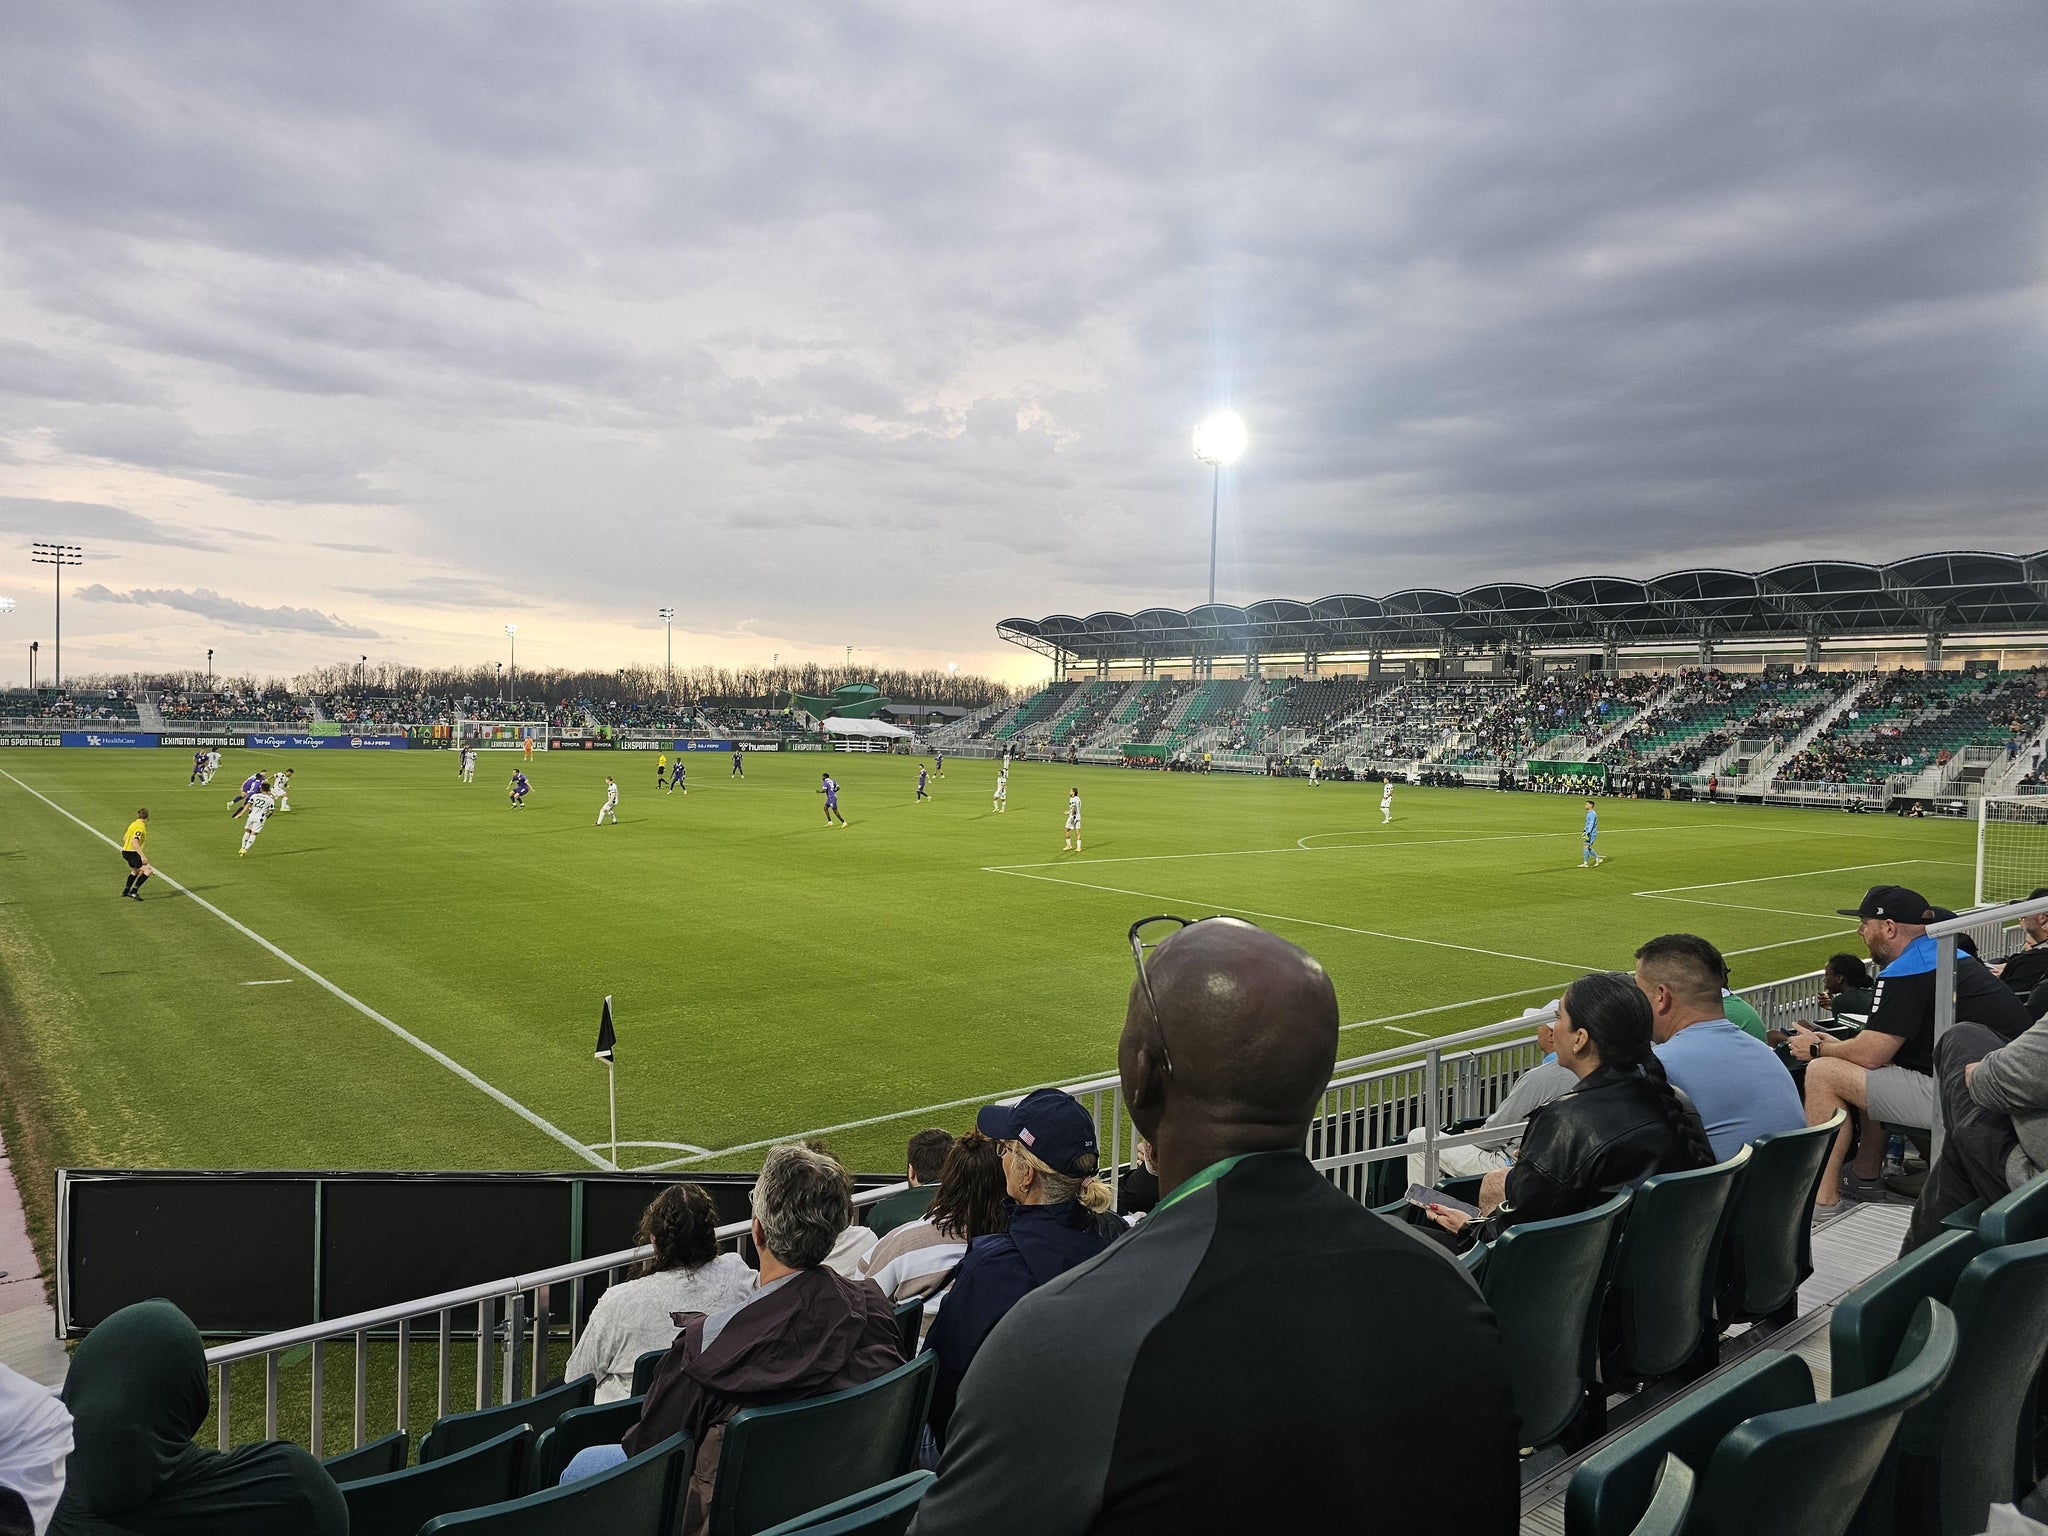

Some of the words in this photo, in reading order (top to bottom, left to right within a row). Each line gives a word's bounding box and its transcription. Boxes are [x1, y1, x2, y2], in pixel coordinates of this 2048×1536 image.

[10, 738, 43, 746] SPORTING
[44, 738, 61, 746] CLUB
[161, 737, 196, 746] LEXINGTON
[197, 737, 228, 746] SPORTING
[229, 737, 245, 746] CLUB
[264, 736, 287, 748] Kroger
[303, 736, 324, 748] Kroger
[748, 742, 778, 751] hummel
[254, 798, 266, 809] 22
